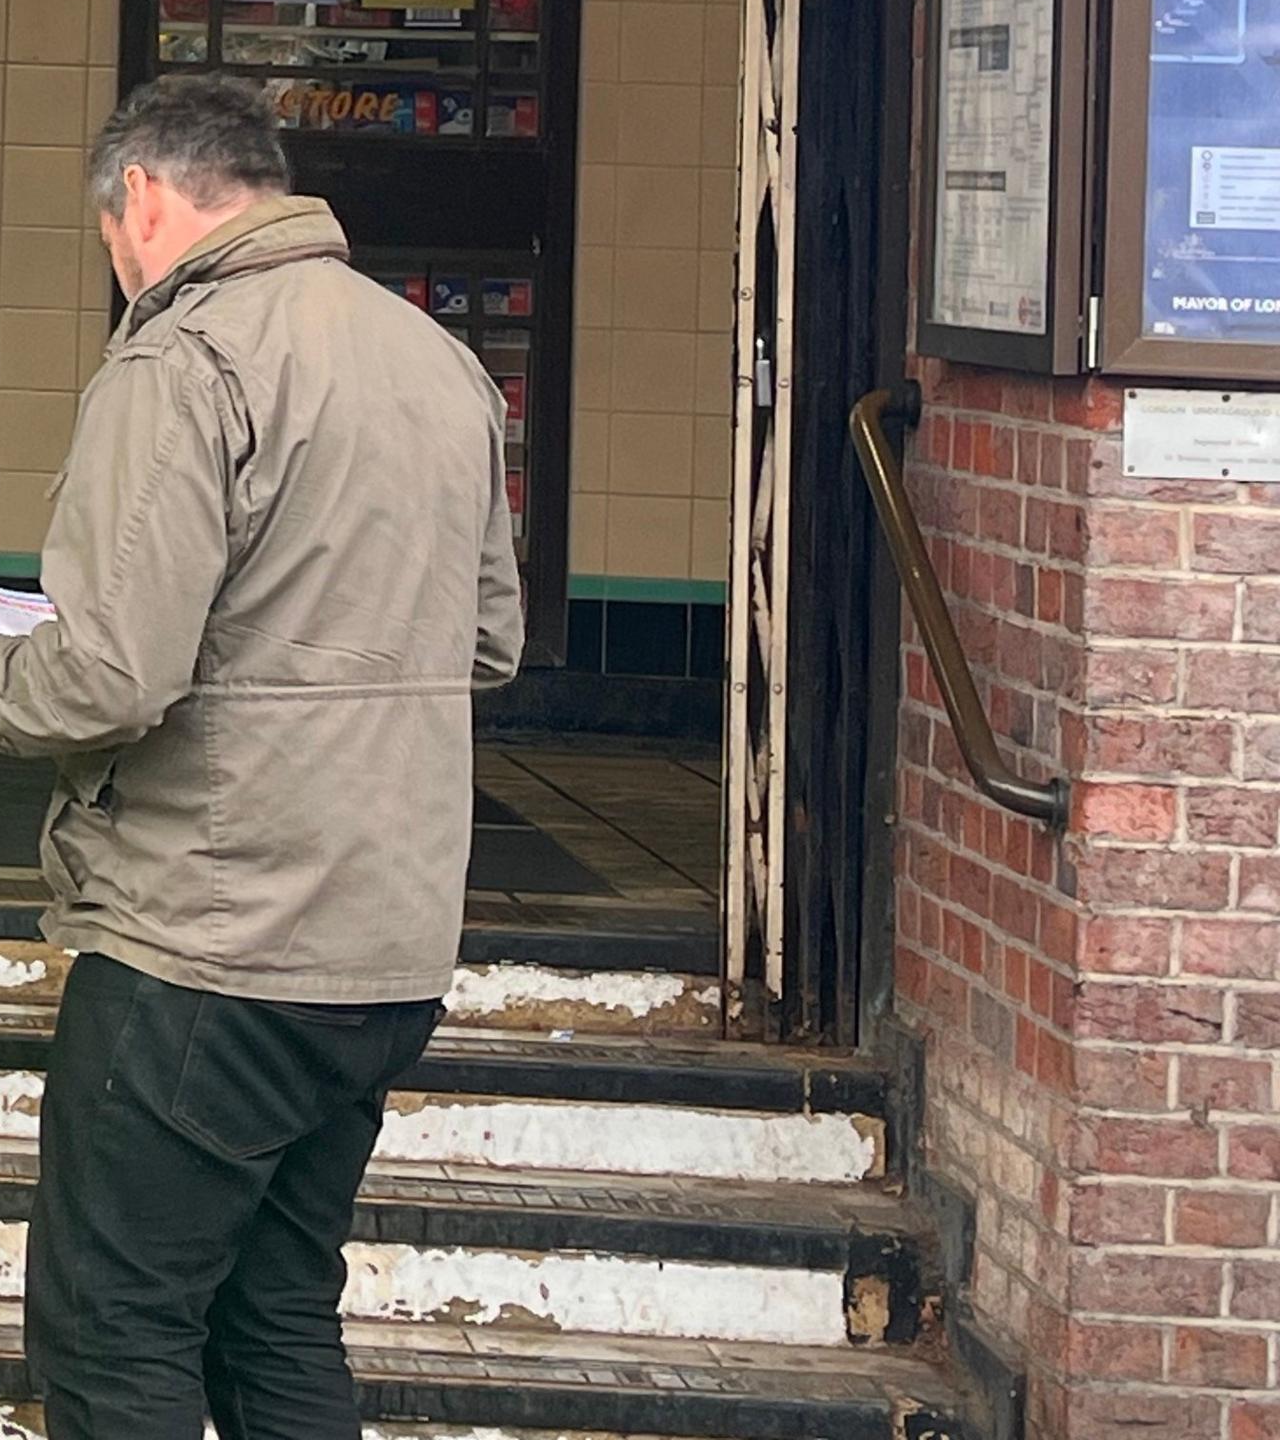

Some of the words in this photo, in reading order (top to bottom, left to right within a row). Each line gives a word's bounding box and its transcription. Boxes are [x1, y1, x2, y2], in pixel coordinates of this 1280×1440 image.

[279, 88, 400, 122] STORE
[1172, 296, 1229, 311] MAYOR
[1230, 297, 1253, 312] OF
